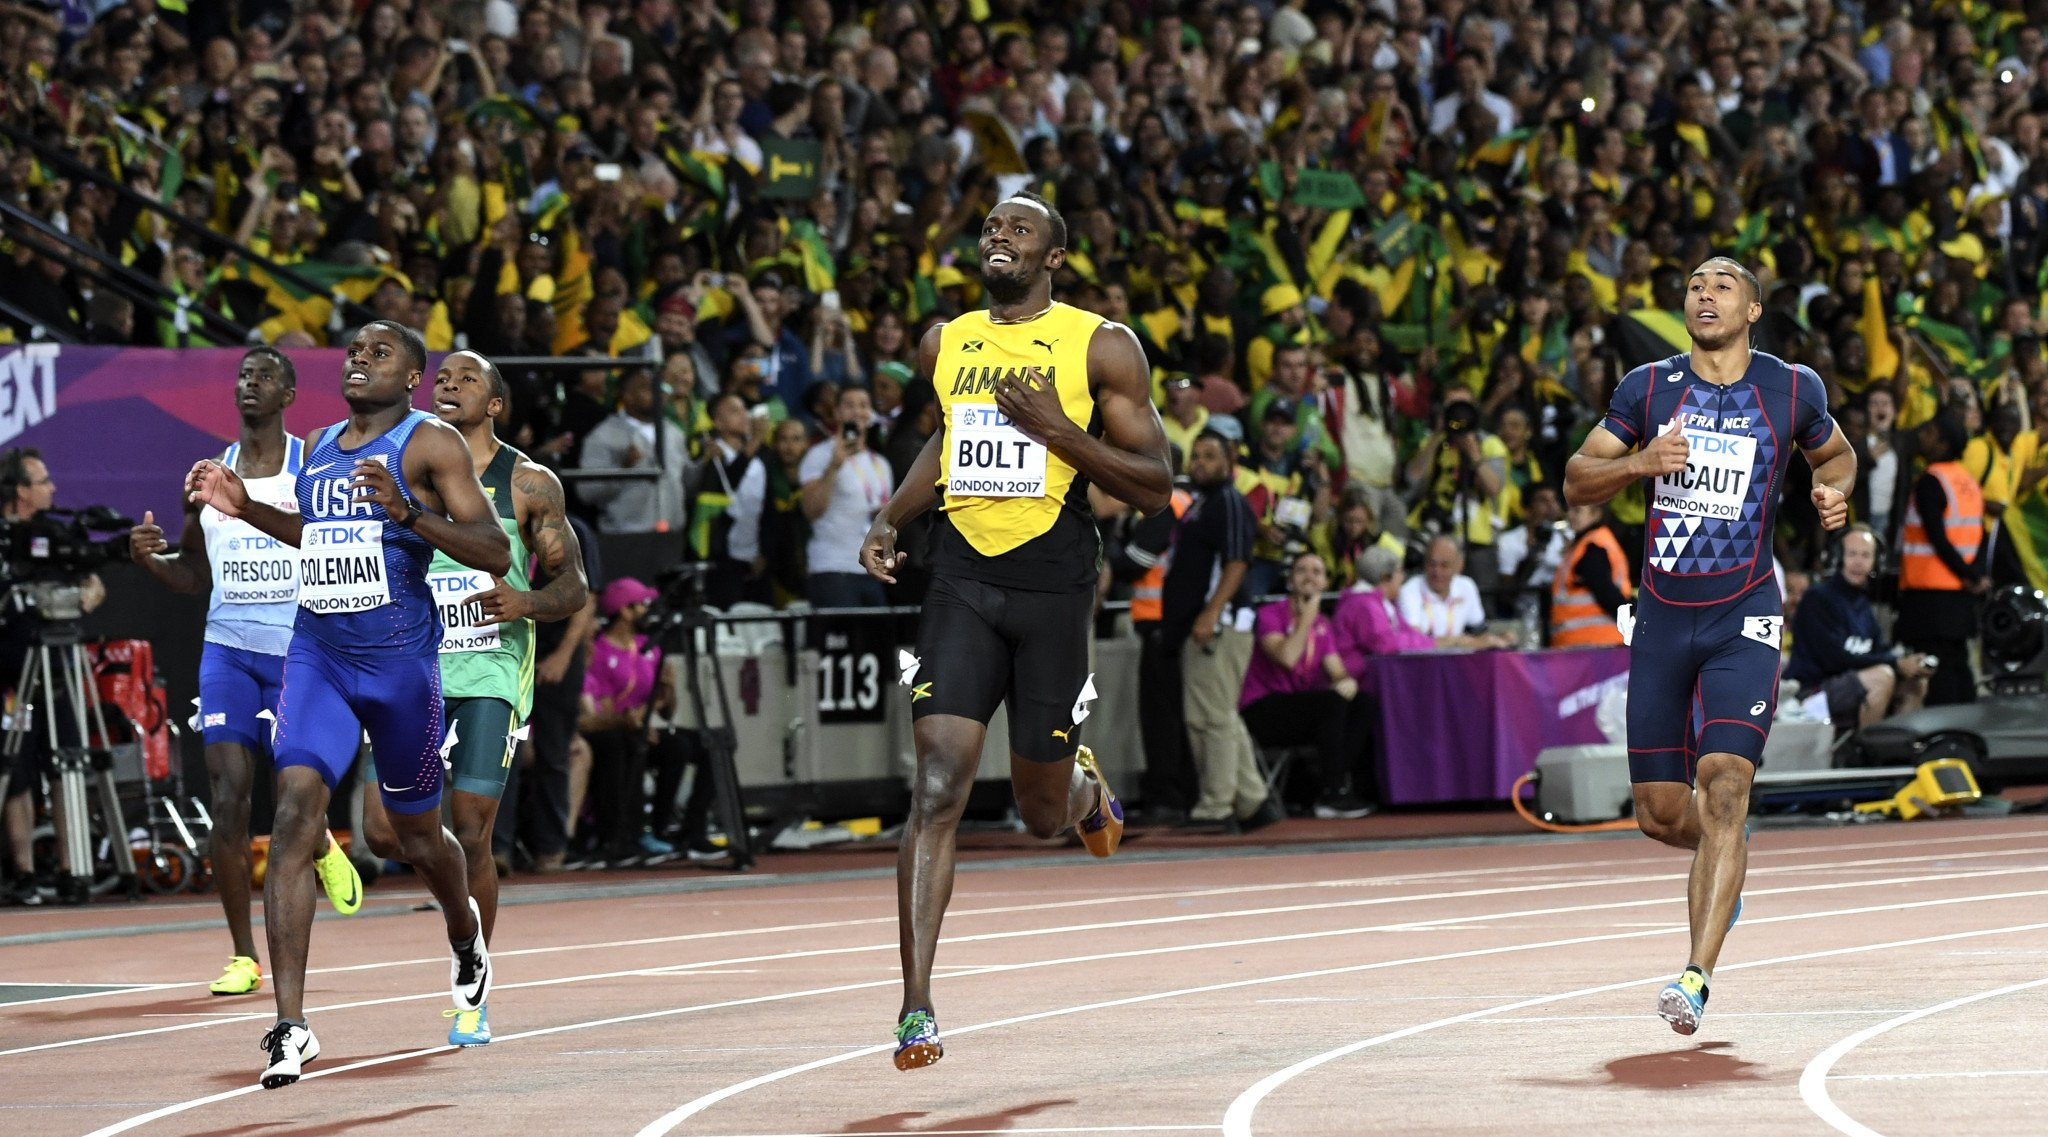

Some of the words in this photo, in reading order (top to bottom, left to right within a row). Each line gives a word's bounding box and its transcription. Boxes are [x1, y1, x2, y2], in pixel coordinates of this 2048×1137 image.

[977, 408, 1016, 427] TD
[958, 439, 1031, 469] BOLT
[1687, 434, 1740, 456] TDK
[950, 479, 1003, 493] LONDON
[1007, 481, 1041, 493] 2017
[312, 475, 373, 518] USA
[1657, 494, 1709, 514] LONDON
[1711, 503, 1740, 518] 2017
[241, 537, 283, 550] TDK
[318, 526, 366, 545] TDK
[223, 559, 292, 582] PRESCOD
[300, 555, 381, 587] COLEMAN
[431, 575, 480, 593] TDK
[224, 590, 268, 601] LONDON
[270, 588, 295, 599] 2017
[299, 597, 350, 611] LONDON
[352, 594, 385, 608] 2017
[1756, 618, 1773, 639] 3
[466, 635, 496, 649] 2017
[819, 652, 880, 711] 113
